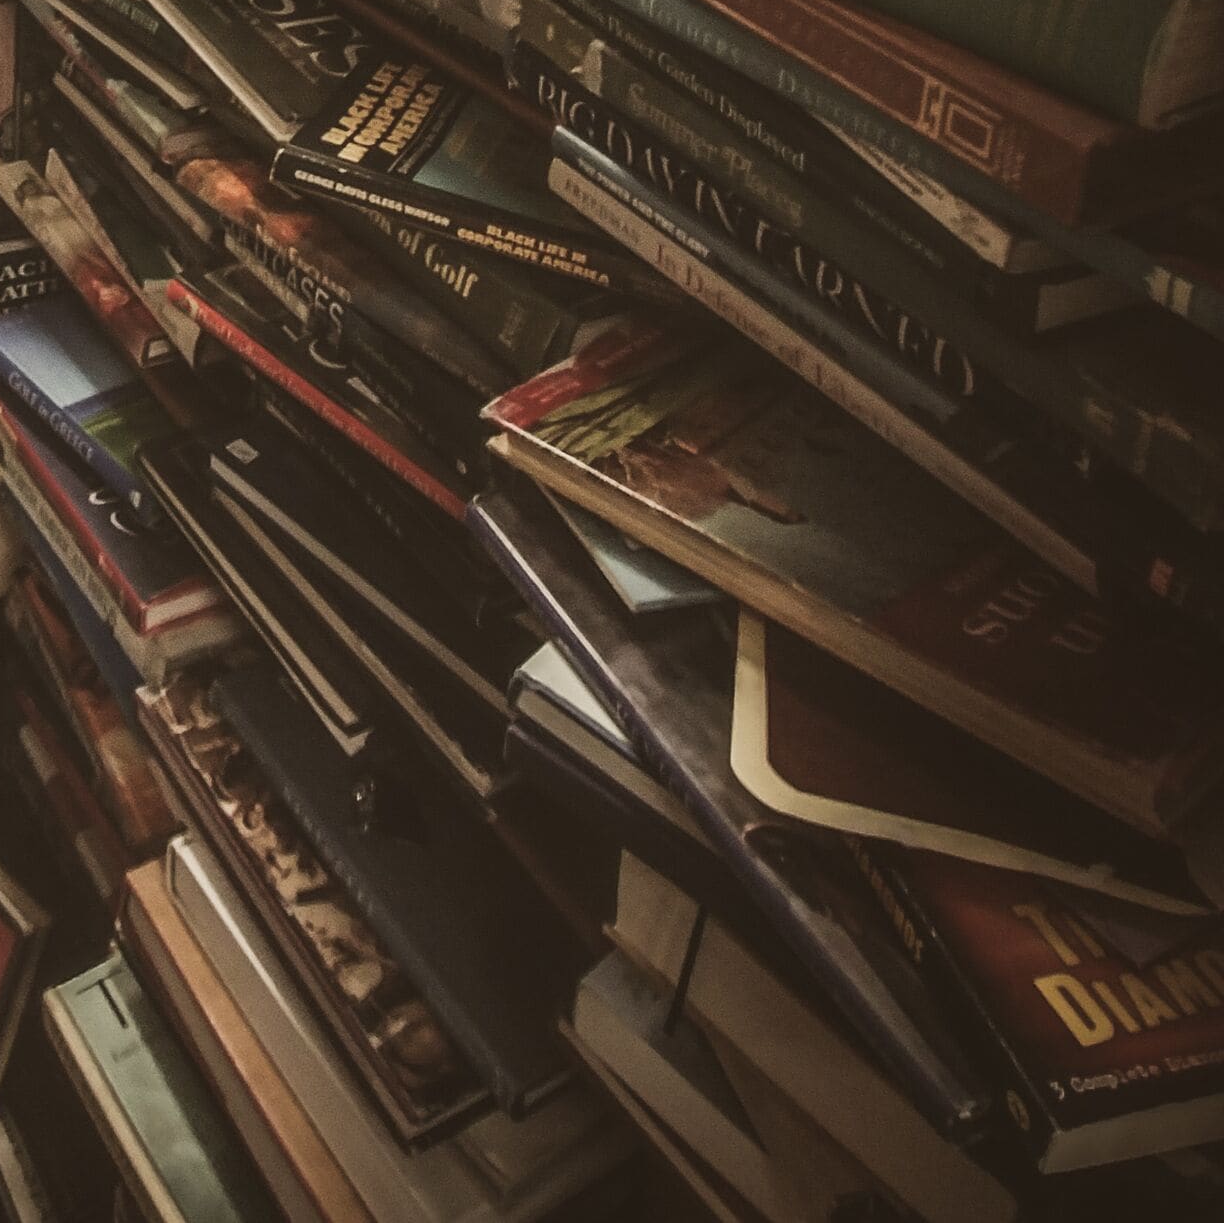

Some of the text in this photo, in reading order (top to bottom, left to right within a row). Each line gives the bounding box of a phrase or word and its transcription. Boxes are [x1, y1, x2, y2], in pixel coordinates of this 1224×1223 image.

[657, 50, 715, 107] Garden
[321, 92, 379, 145] BLACK
[378, 82, 444, 156] AMERICA
[403, 202, 451, 228] WATSON
[396, 226, 480, 299] of Golf
[456, 226, 611, 288] CORPORATE AMERICA
[485, 223, 589, 266] BLACK LIFE IN
[1070, 1062, 1161, 1095] Complete
